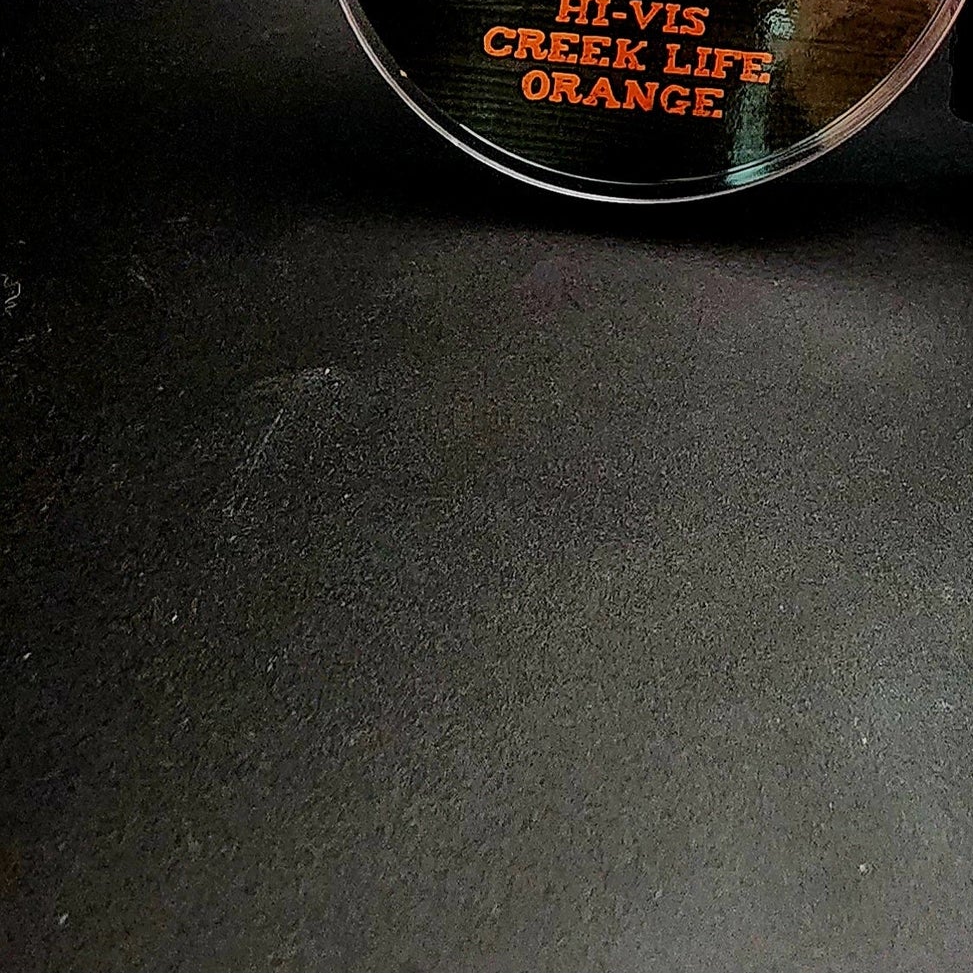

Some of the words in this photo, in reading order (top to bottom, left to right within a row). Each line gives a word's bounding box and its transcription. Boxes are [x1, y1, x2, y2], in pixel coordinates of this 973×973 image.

[483, 26, 648, 71] CREEK
[663, 43, 773, 84] LIFE
[522, 71, 724, 118] ORANGE
